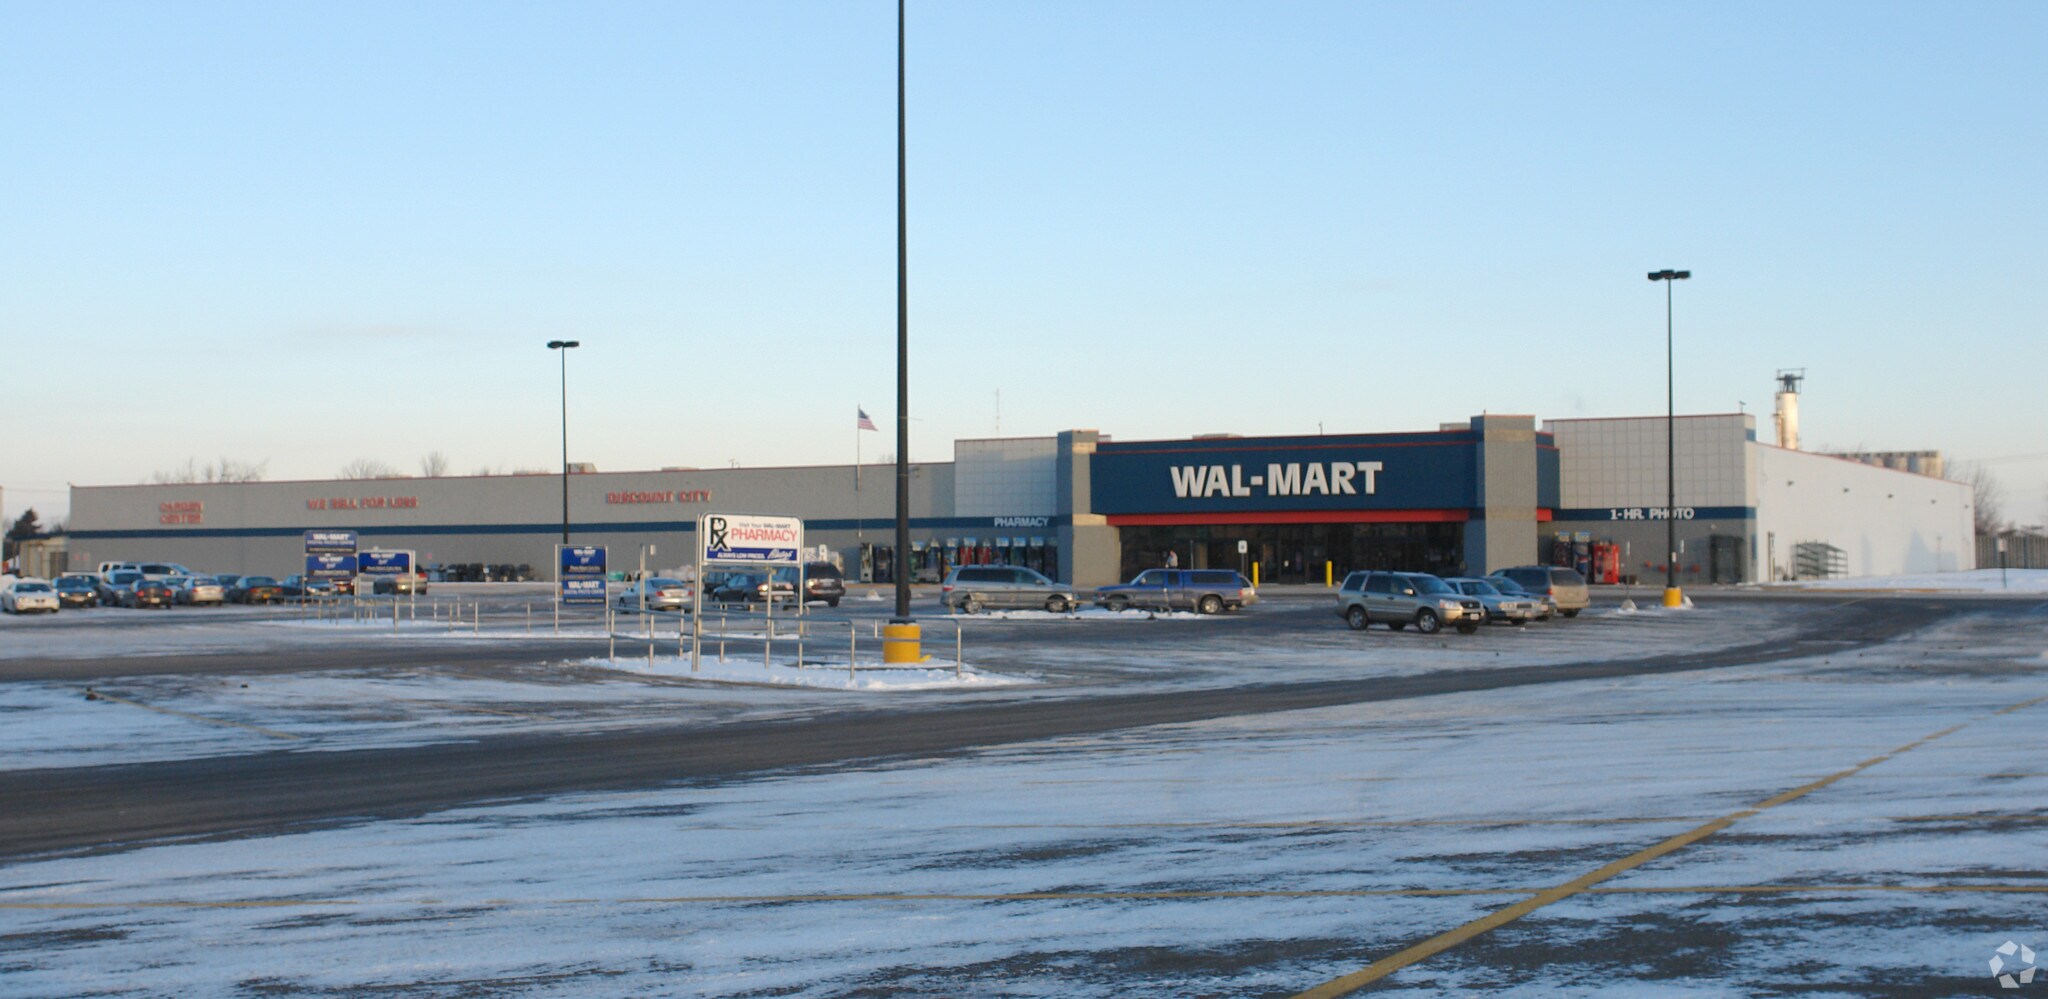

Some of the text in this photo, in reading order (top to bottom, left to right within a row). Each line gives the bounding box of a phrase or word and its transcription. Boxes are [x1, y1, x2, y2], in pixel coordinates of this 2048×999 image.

[1170, 461, 1383, 498] WAL-MART
[307, 496, 419, 510] WE SELL FOR LESS
[606, 489, 713, 504] DISCOUNT CITY
[160, 513, 204, 524] CENTER
[994, 517, 1049, 527] PHARMACY
[731, 528, 797, 541] PHARMACY
